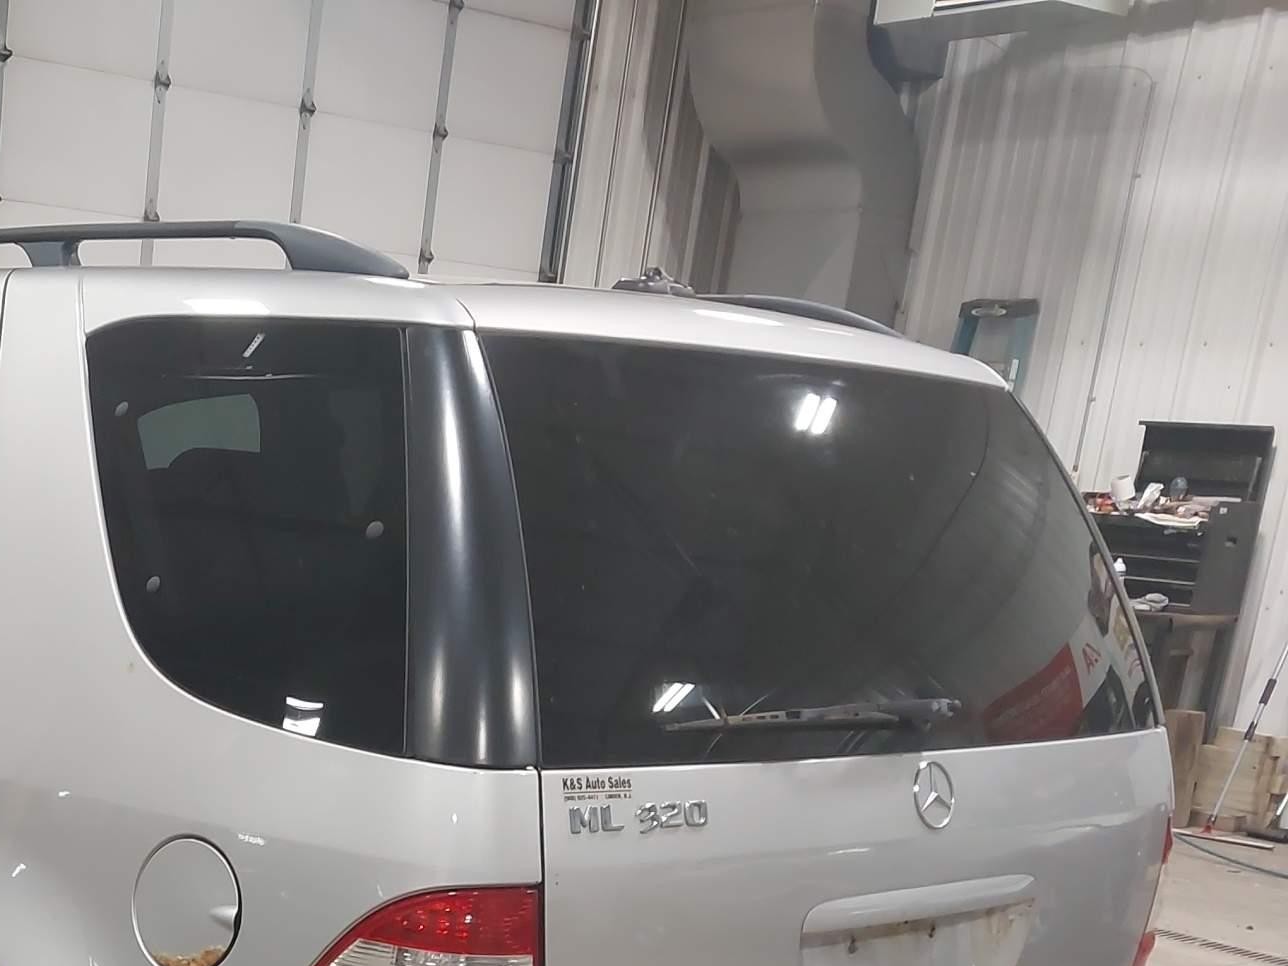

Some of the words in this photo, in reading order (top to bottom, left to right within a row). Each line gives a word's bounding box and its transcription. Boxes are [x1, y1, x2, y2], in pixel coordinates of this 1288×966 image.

[562, 777, 583, 791] K&S
[585, 776, 606, 790] Auto
[608, 775, 632, 789] Sales
[569, 803, 624, 834] ML
[635, 800, 708, 834] 320
